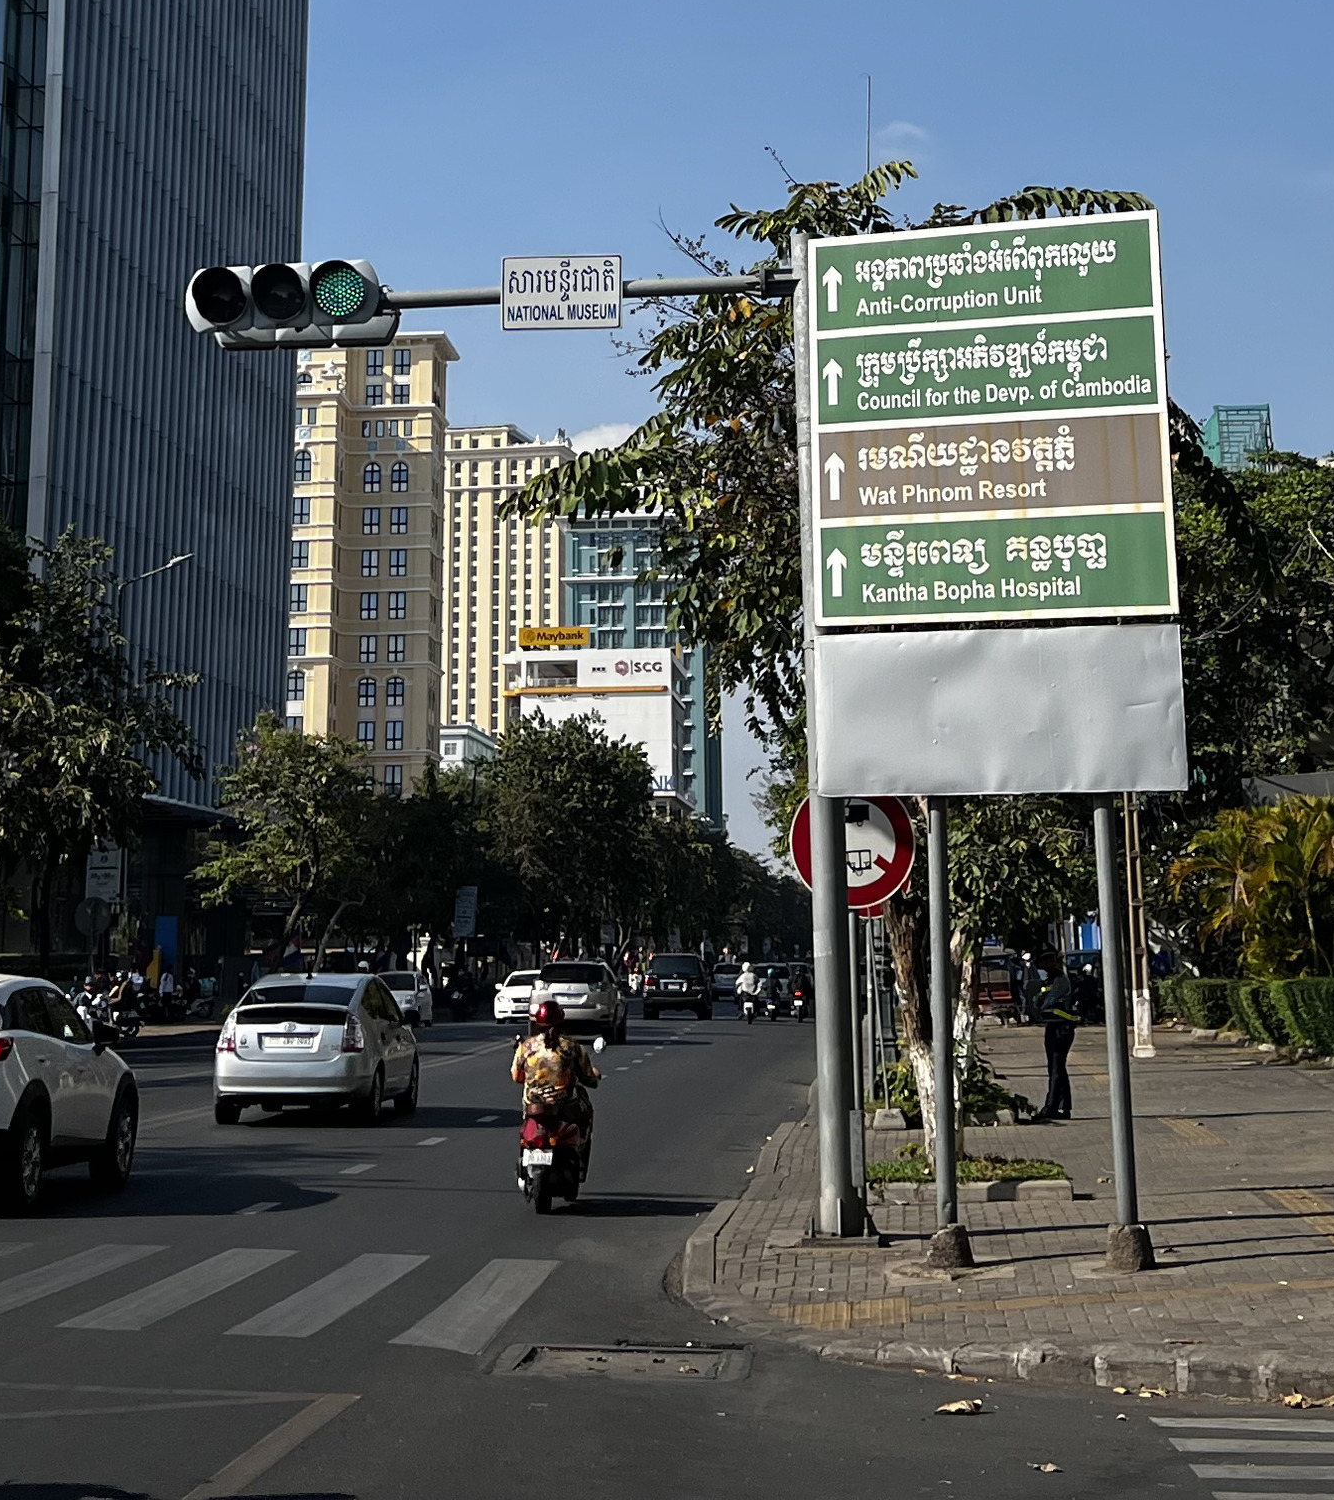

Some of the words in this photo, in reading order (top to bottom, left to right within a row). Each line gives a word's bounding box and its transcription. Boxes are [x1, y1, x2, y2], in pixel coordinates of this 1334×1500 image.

[855, 235, 1117, 292] អង្គភាពប្រឆាំងអំពើពុករលួយ
[508, 259, 615, 302] សារមន្ទីរជាតិ
[507, 305, 564, 322] NATIONAL
[567, 303, 616, 320] MUSEUM
[855, 289, 998, 317] Anti-Corruption
[1003, 284, 1042, 306] Unit
[857, 388, 921, 411] Council
[925, 386, 949, 407] for
[953, 384, 982, 405] the
[985, 383, 1035, 407] Devp.
[1039, 380, 1058, 400] of
[1062, 374, 1152, 398] Cambodia
[858, 424, 1076, 477] រមណីយដ្ឋានវត្តភ្នំ
[858, 486, 897, 506] Wat
[902, 483, 973, 504] Phnom
[978, 478, 1047, 500] Resort
[860, 529, 990, 578] មន្ទីរពេទ្យ
[862, 581, 928, 604] Kantha
[933, 579, 996, 604] Bopha
[1001, 575, 1081, 601] Hospital
[536, 630, 585, 643] Maybank
[634, 661, 663, 673] SCG
